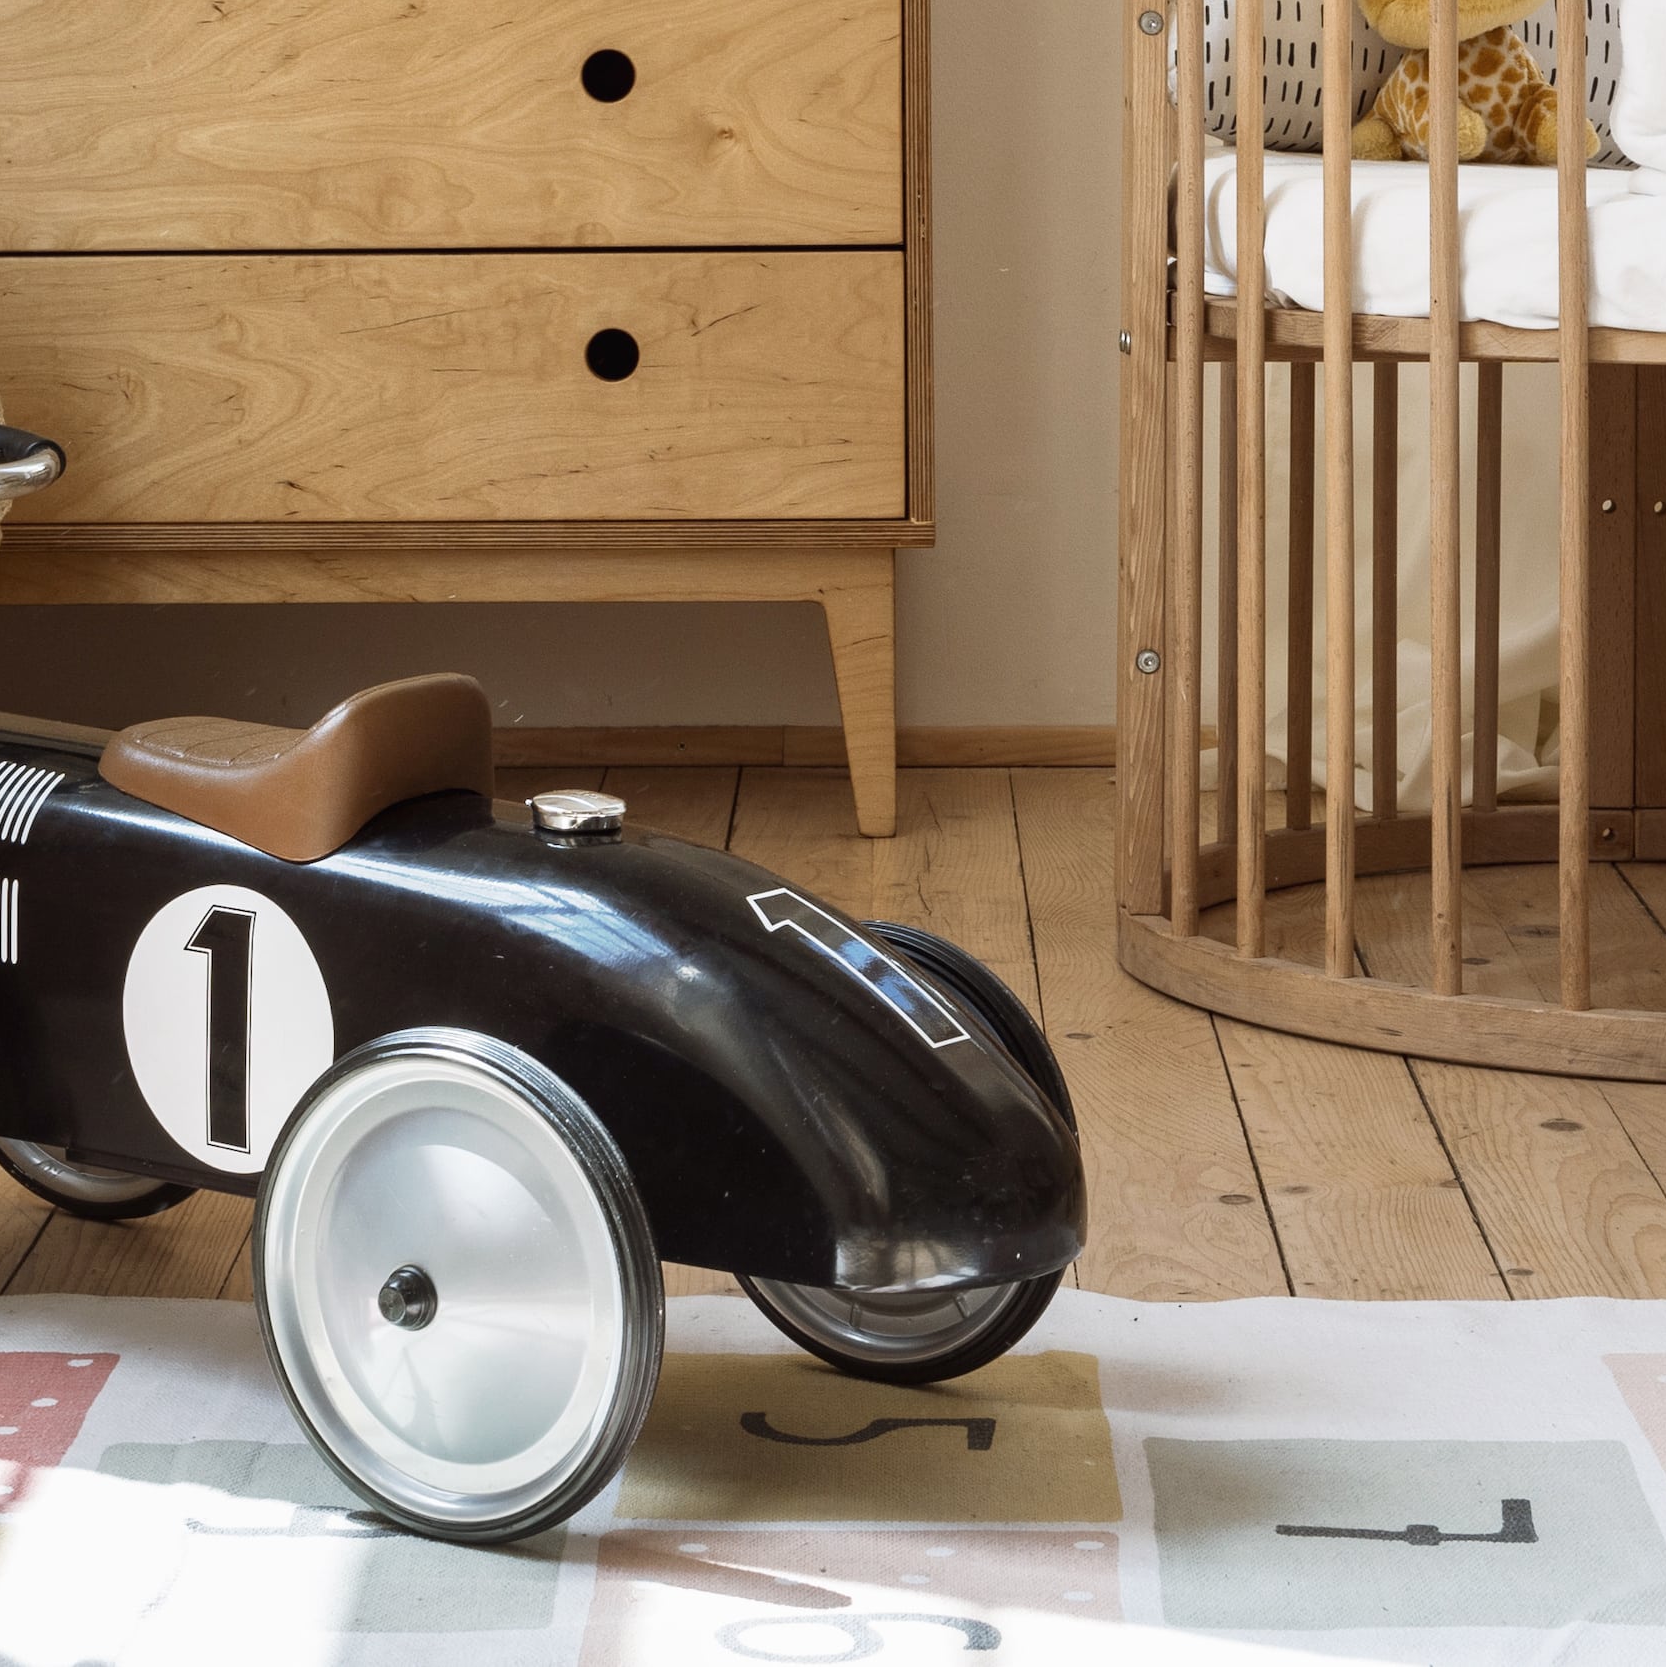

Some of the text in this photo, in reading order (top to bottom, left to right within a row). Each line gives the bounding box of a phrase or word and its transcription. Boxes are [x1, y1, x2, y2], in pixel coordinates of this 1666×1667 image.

[183, 904, 256, 1154] 1
[741, 1411, 997, 1452] 5
[1275, 1498, 1538, 1545] 7
[714, 1611, 1003, 1664] 6
